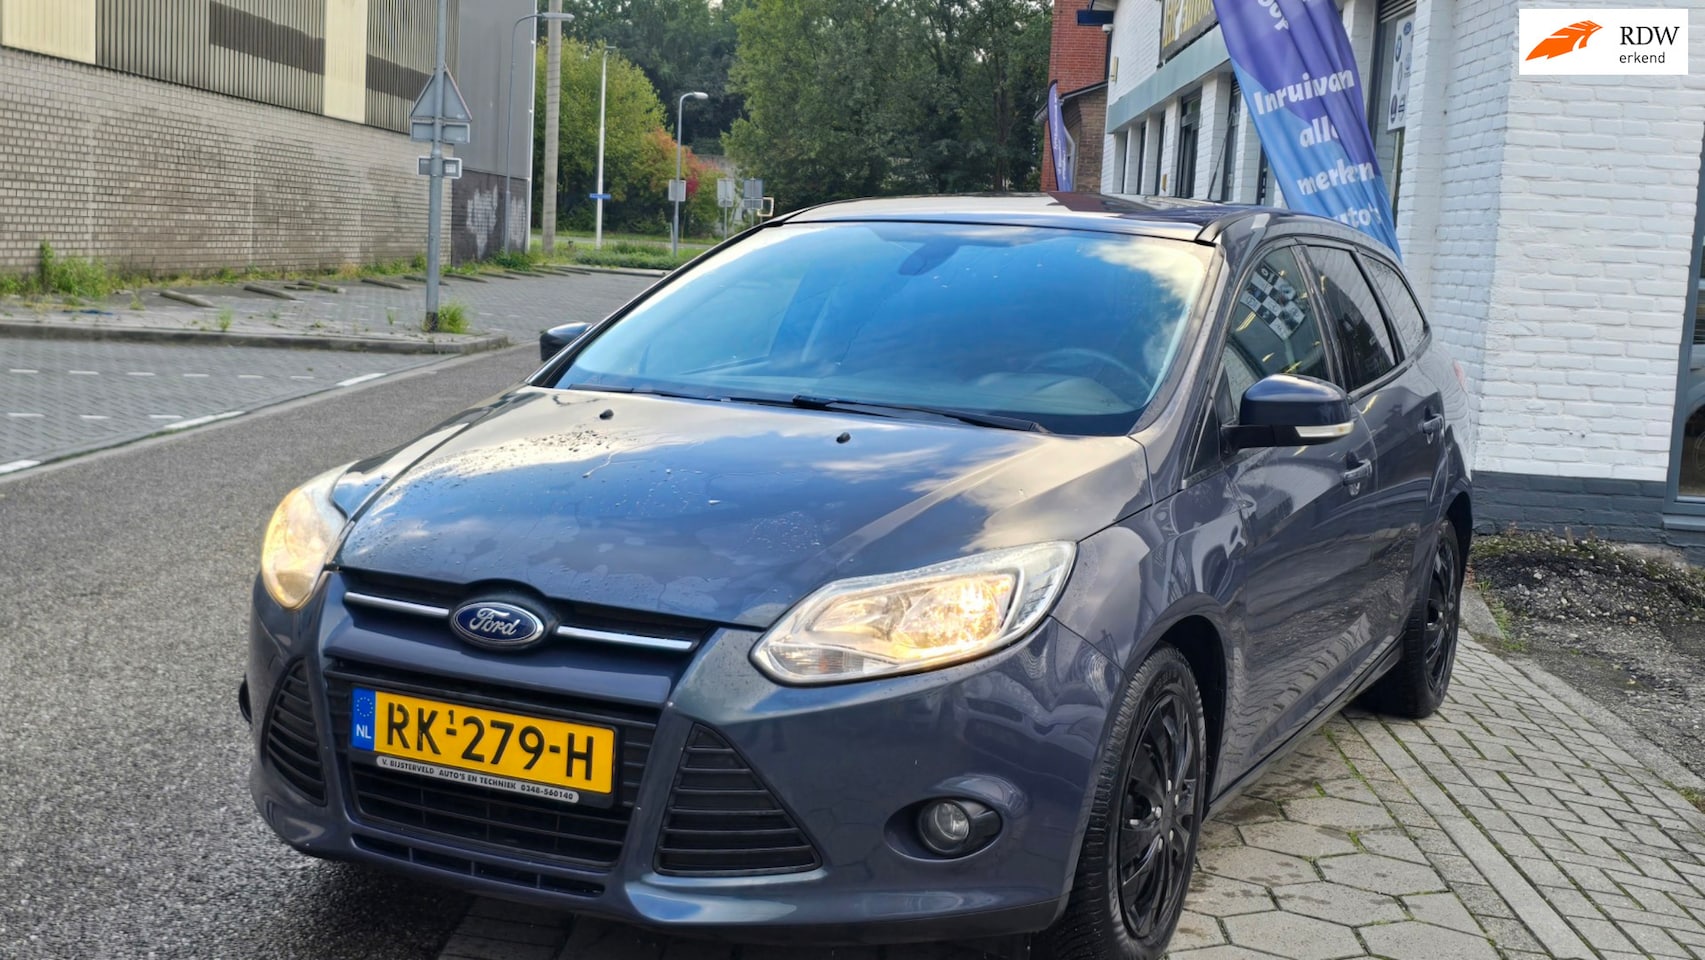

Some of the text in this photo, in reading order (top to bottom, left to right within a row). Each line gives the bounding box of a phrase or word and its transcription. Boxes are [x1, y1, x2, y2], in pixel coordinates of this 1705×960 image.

[469, 608, 521, 635] Ford
[356, 724, 372, 739] NL
[390, 760, 435, 775] BIJSTERVELD
[439, 769, 465, 780] AUTO'S
[467, 774, 477, 783] EN
[480, 776, 516, 790] TECHNIEK
